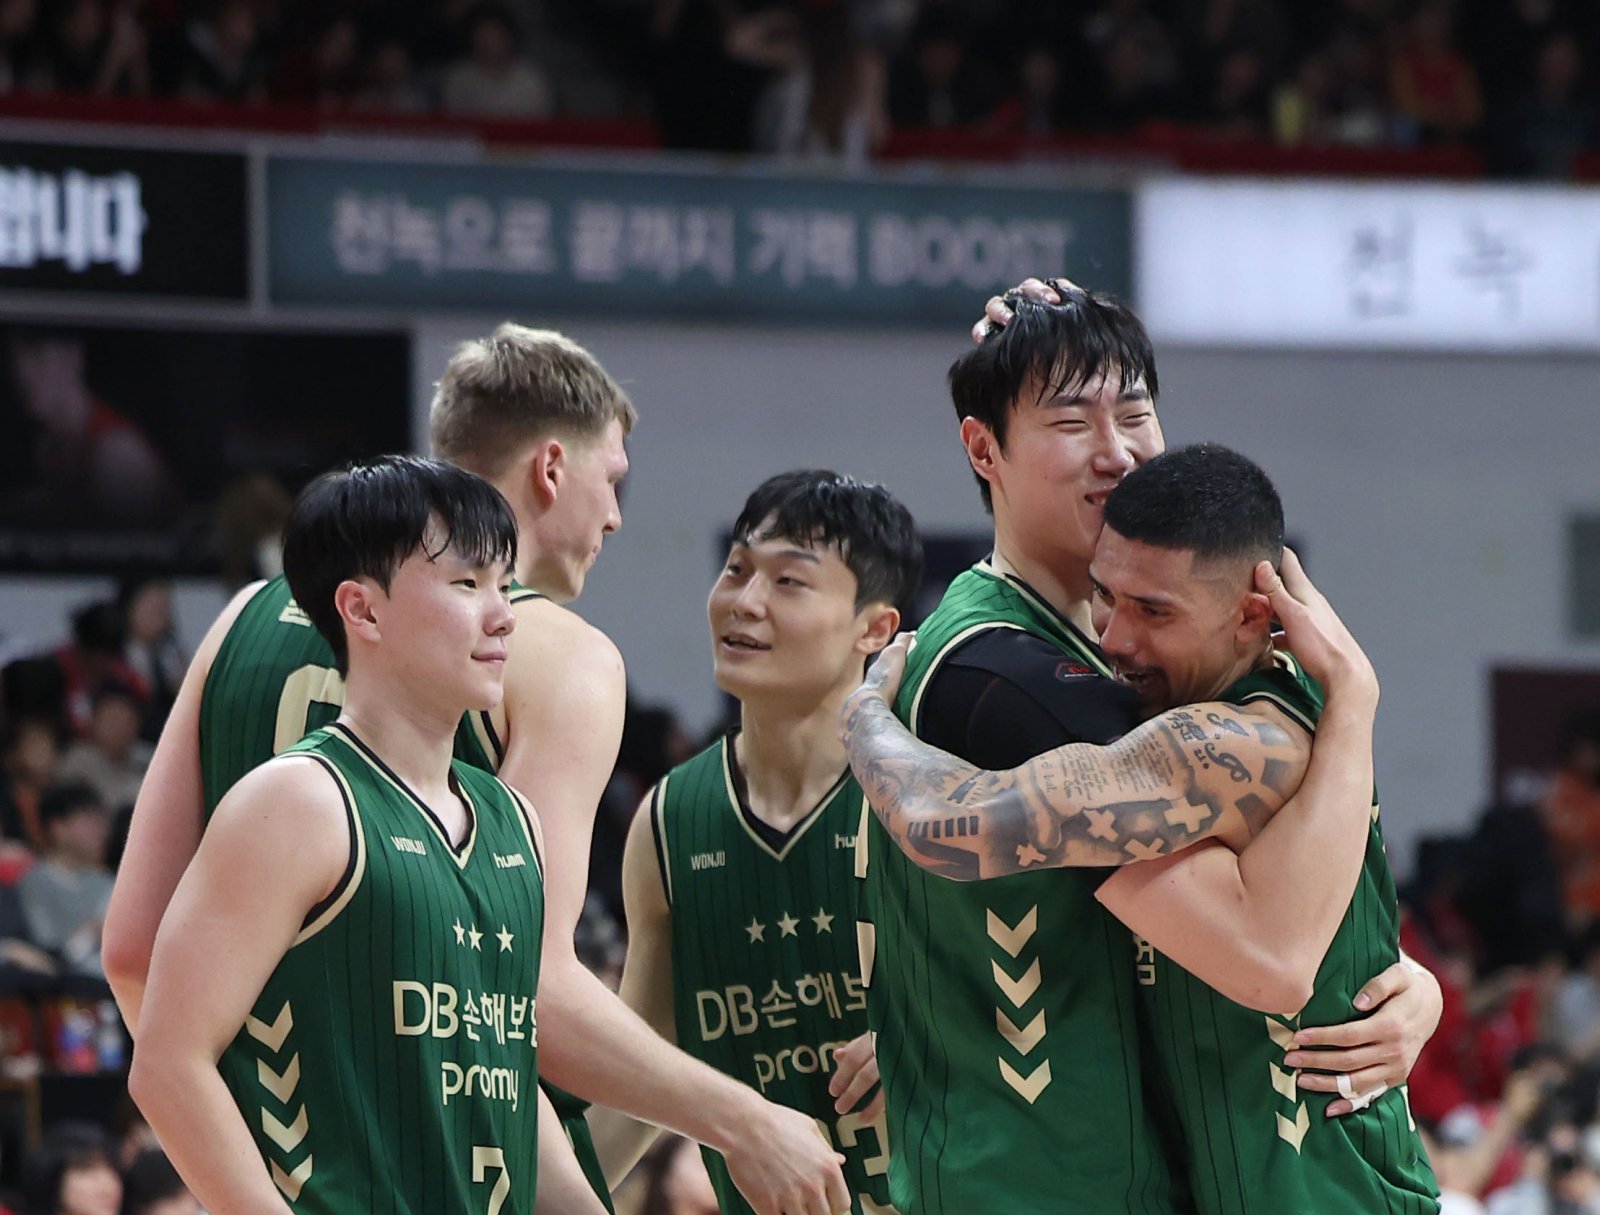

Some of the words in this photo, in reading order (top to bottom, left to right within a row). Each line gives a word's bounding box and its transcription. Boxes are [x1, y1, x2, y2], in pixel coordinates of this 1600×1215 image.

[391, 836, 427, 856] WONJU
[690, 851, 726, 871] WONJU
[697, 972, 867, 1041] DB손해보
[441, 1061, 519, 1112] promy
